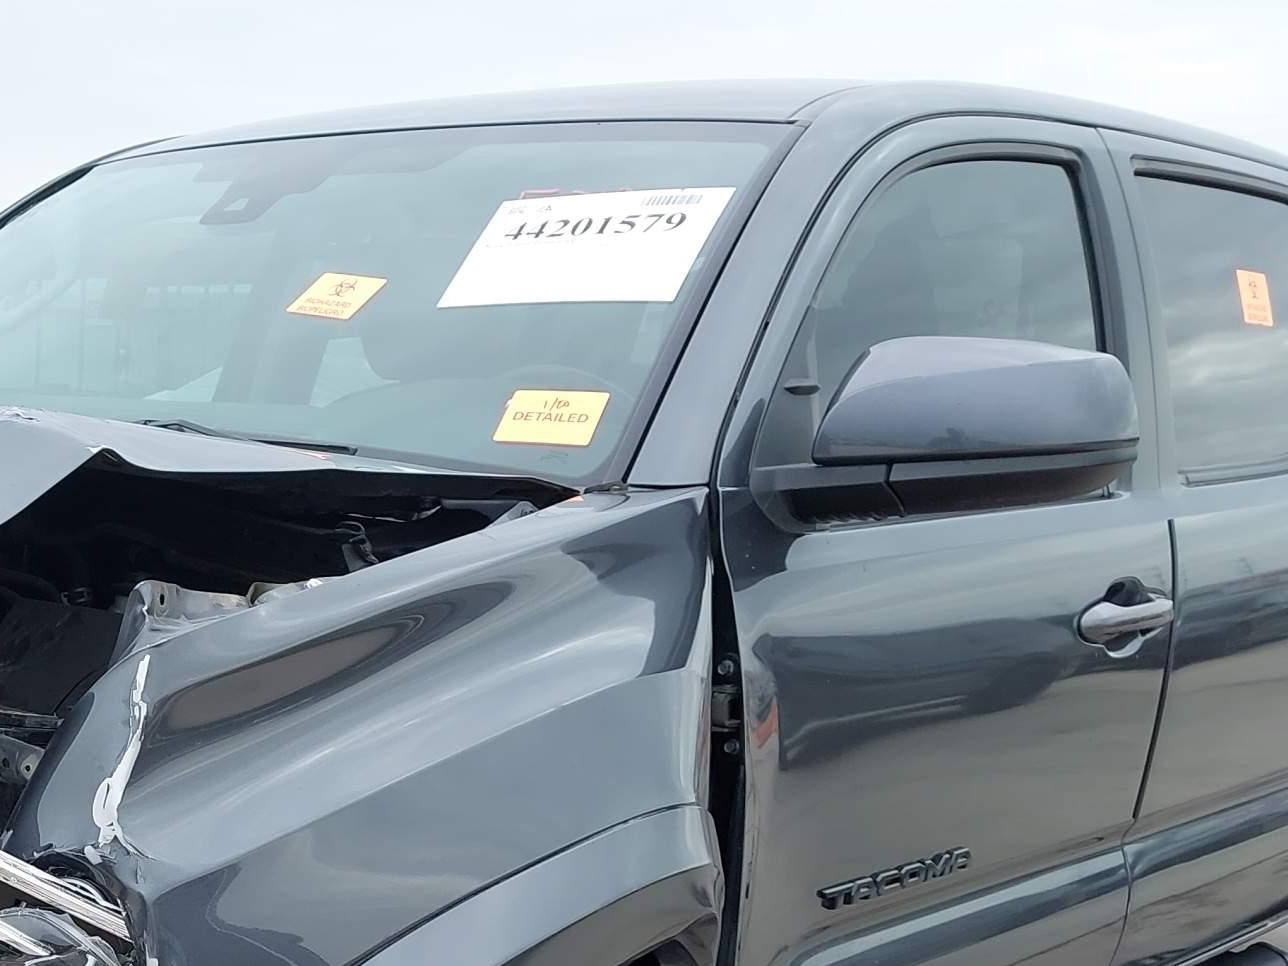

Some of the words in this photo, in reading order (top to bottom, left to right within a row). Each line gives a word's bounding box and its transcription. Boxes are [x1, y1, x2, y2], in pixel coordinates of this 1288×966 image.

[504, 212, 687, 240] 44201579
[512, 411, 589, 423] DETAILED
[816, 846, 971, 911] TACOMA
